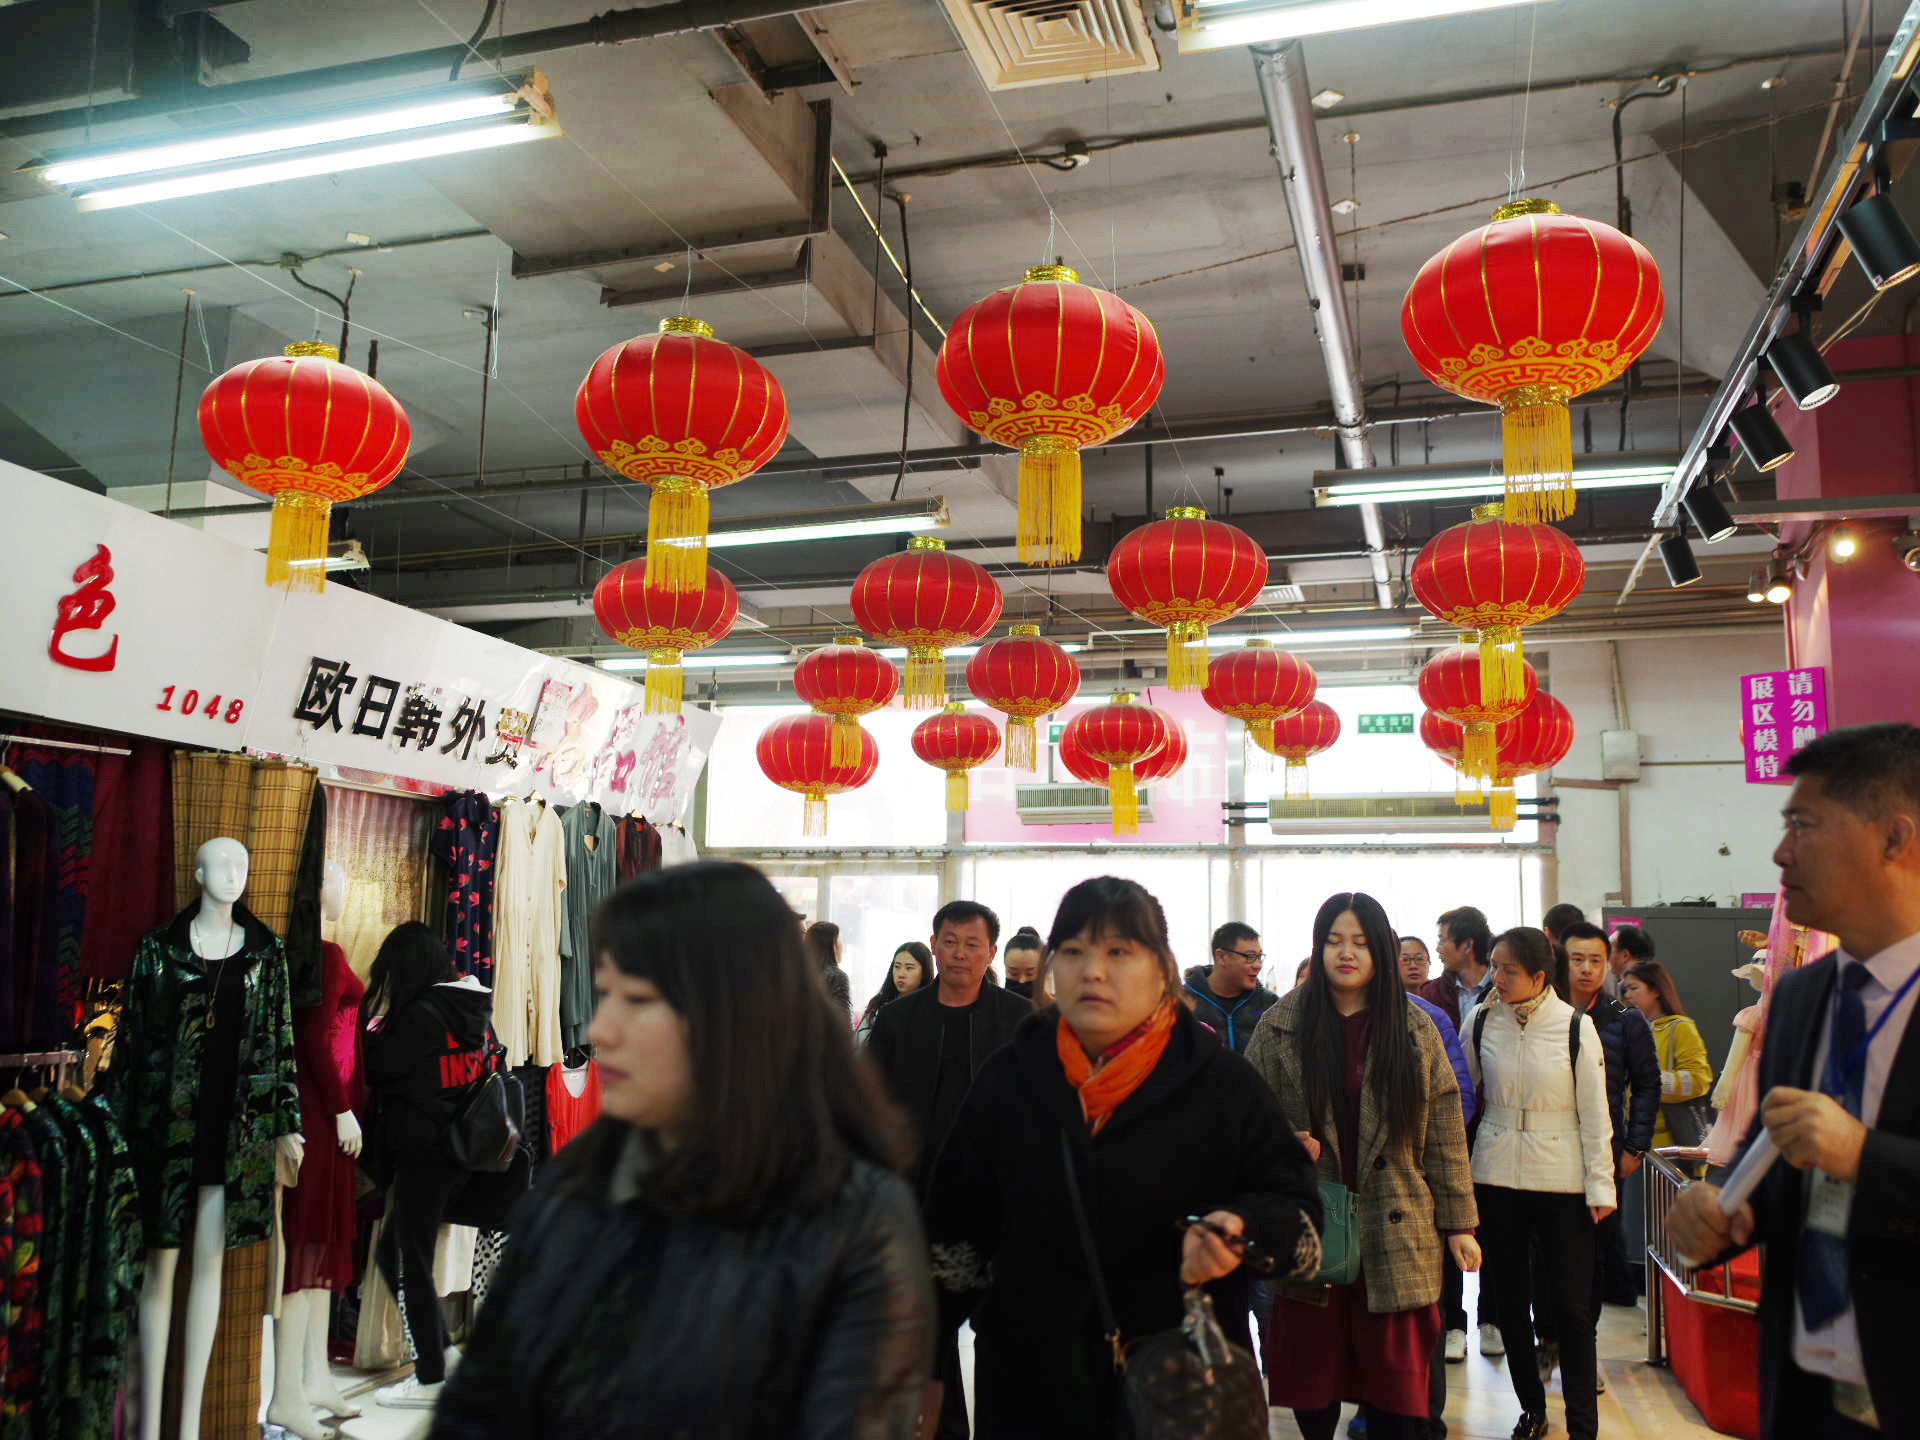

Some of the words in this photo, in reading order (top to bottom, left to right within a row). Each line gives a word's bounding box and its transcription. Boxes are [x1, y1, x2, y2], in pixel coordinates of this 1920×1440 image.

[48, 543, 119, 672] 色
[156, 685, 243, 724] 1048
[1750, 676, 1779, 778] 展区模特
